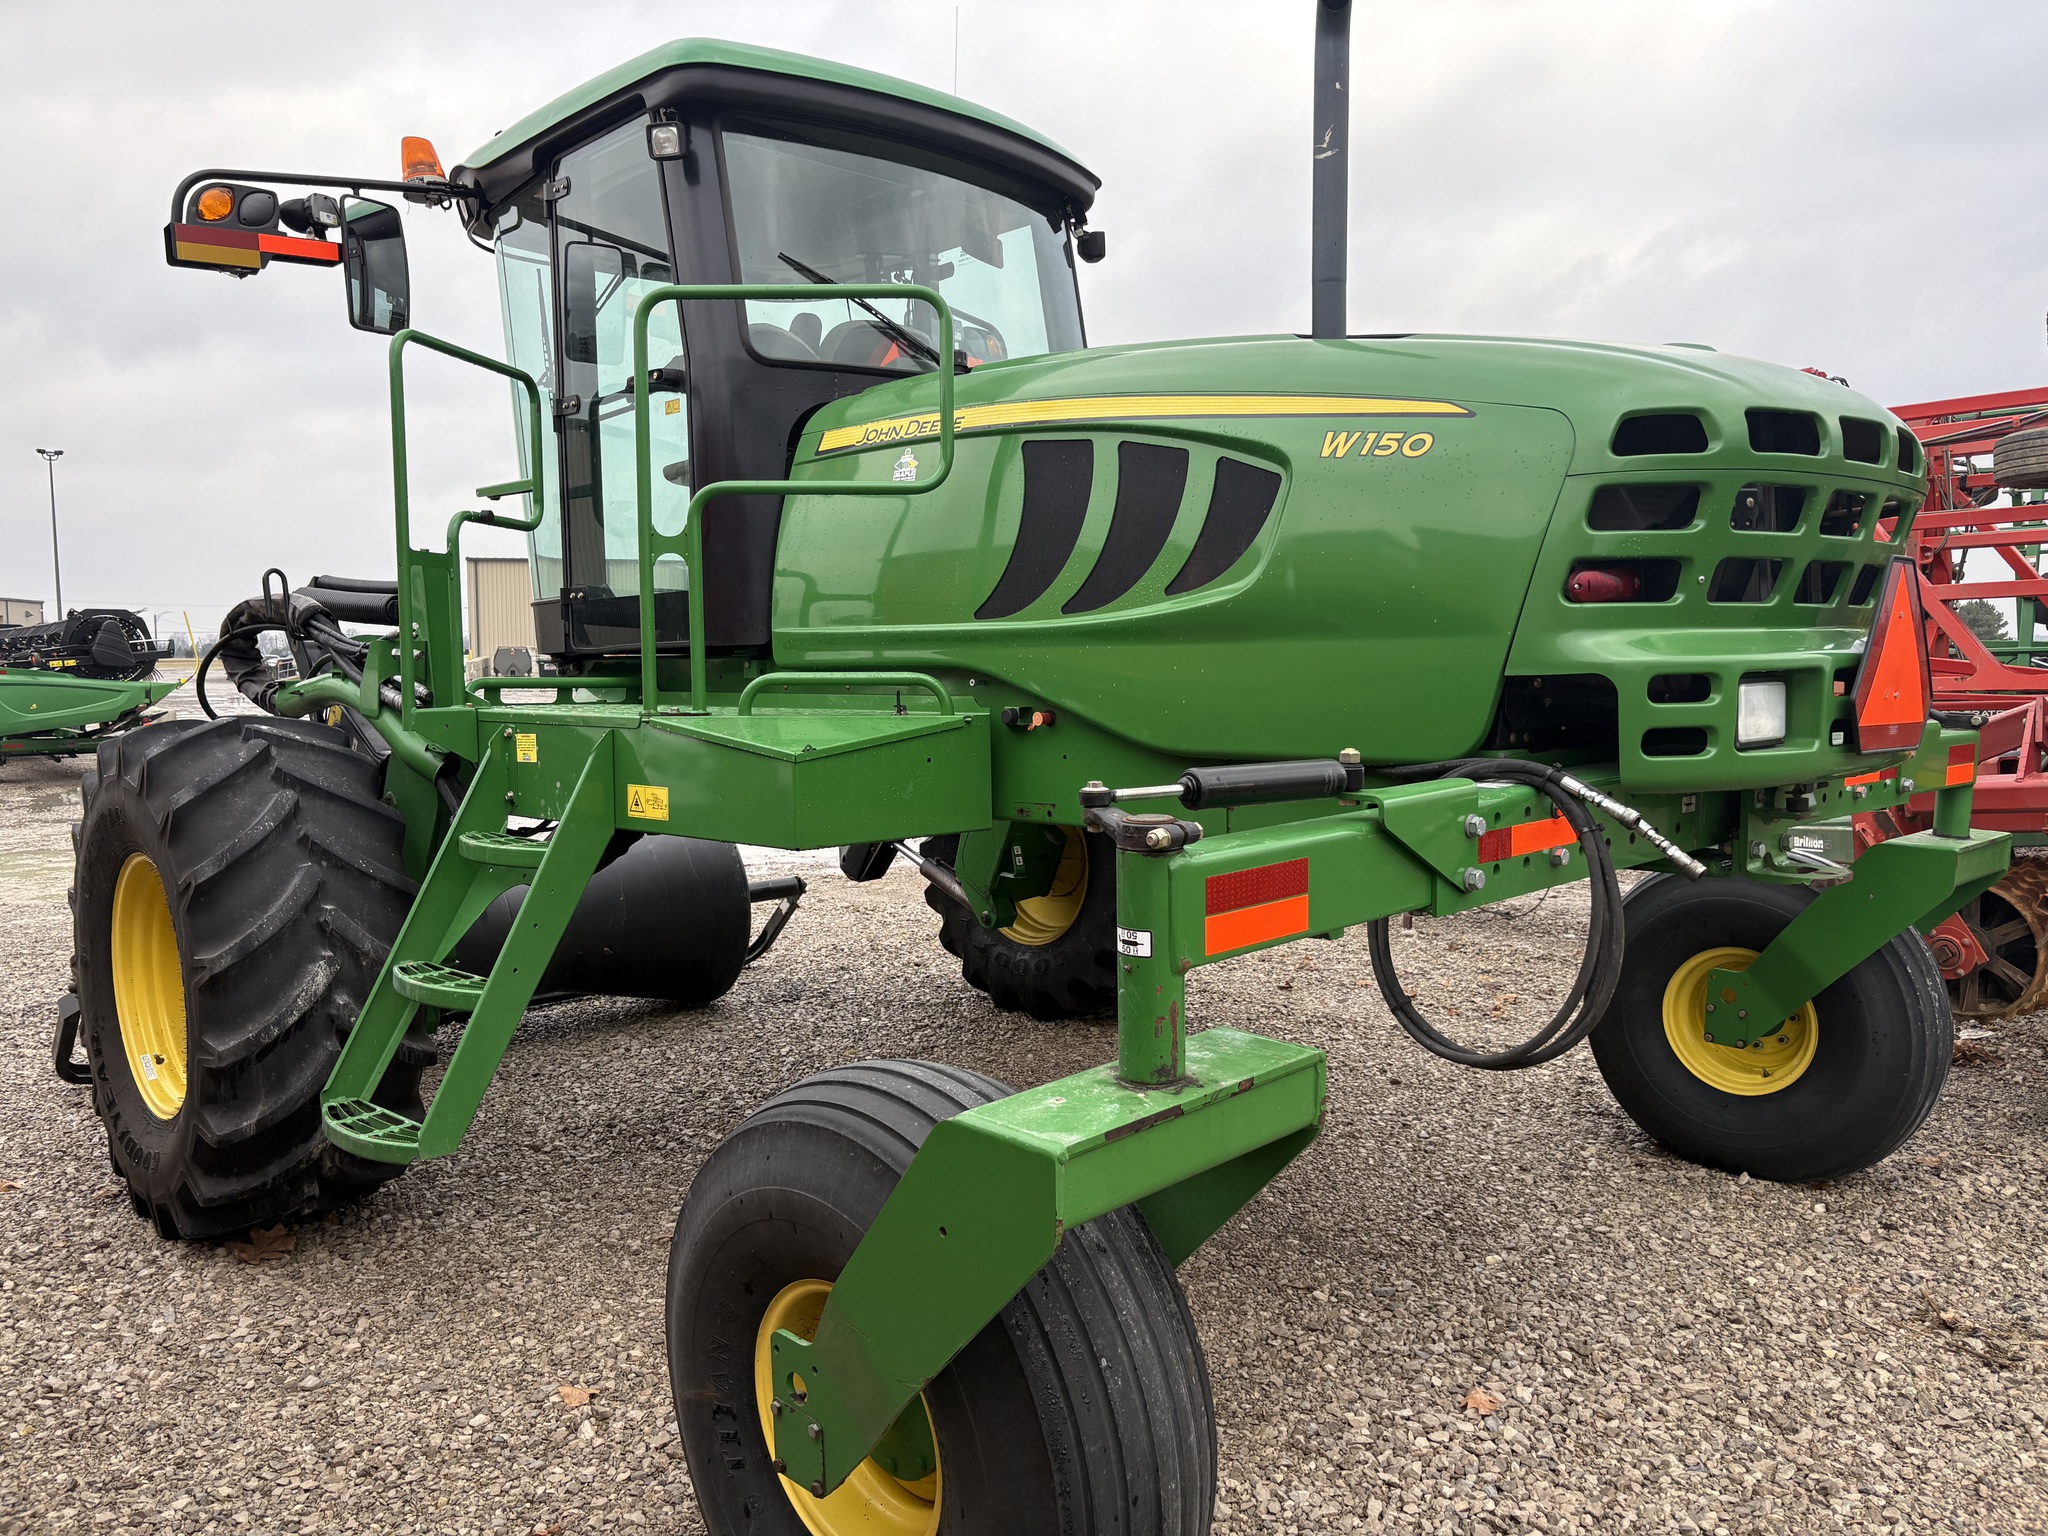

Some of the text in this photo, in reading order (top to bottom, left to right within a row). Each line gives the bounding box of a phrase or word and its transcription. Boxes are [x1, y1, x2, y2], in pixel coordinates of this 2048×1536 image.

[856, 416, 966, 445] JOHN DEEE
[1320, 430, 1435, 458] W150
[90, 1033, 161, 1174] GOODYEAR
